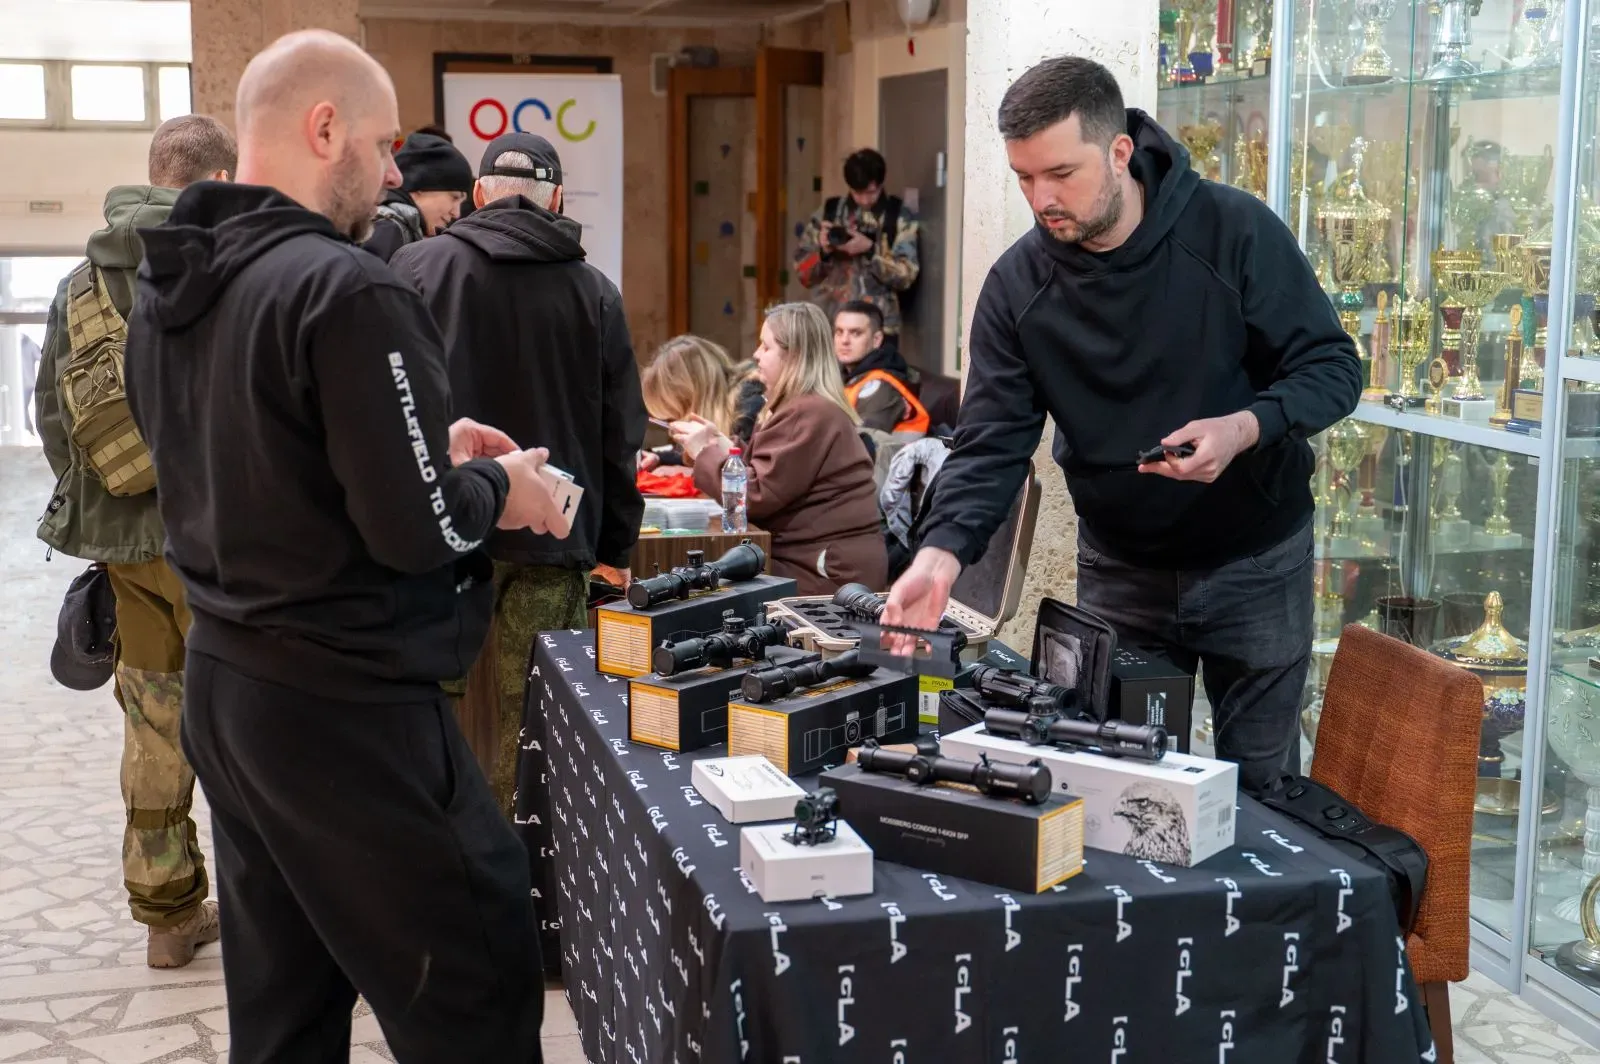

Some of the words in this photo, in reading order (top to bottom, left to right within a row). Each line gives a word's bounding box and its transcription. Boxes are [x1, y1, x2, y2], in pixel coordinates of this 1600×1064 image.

[388, 351, 438, 483] BATTLEFIELD
[429, 487, 446, 515] TO
[880, 816, 911, 829] MOSSBERG
[912, 823, 938, 834] CONDOR
[881, 902, 908, 964] IGLA
[995, 893, 1021, 952] IGLA
[1105, 885, 1132, 942] IGLA
[1215, 877, 1242, 936] IGLA
[1330, 869, 1353, 933] IGLA
[763, 912, 791, 976] IGLA
[1280, 932, 1300, 1008] IGLA
[838, 965, 855, 1046] IGLA
[955, 953, 971, 1034] IGLA
[1064, 944, 1083, 1022] IGLA
[1175, 937, 1193, 1016] IGLA
[1111, 1016, 1128, 1064] IGL
[1219, 1010, 1236, 1064] IGL
